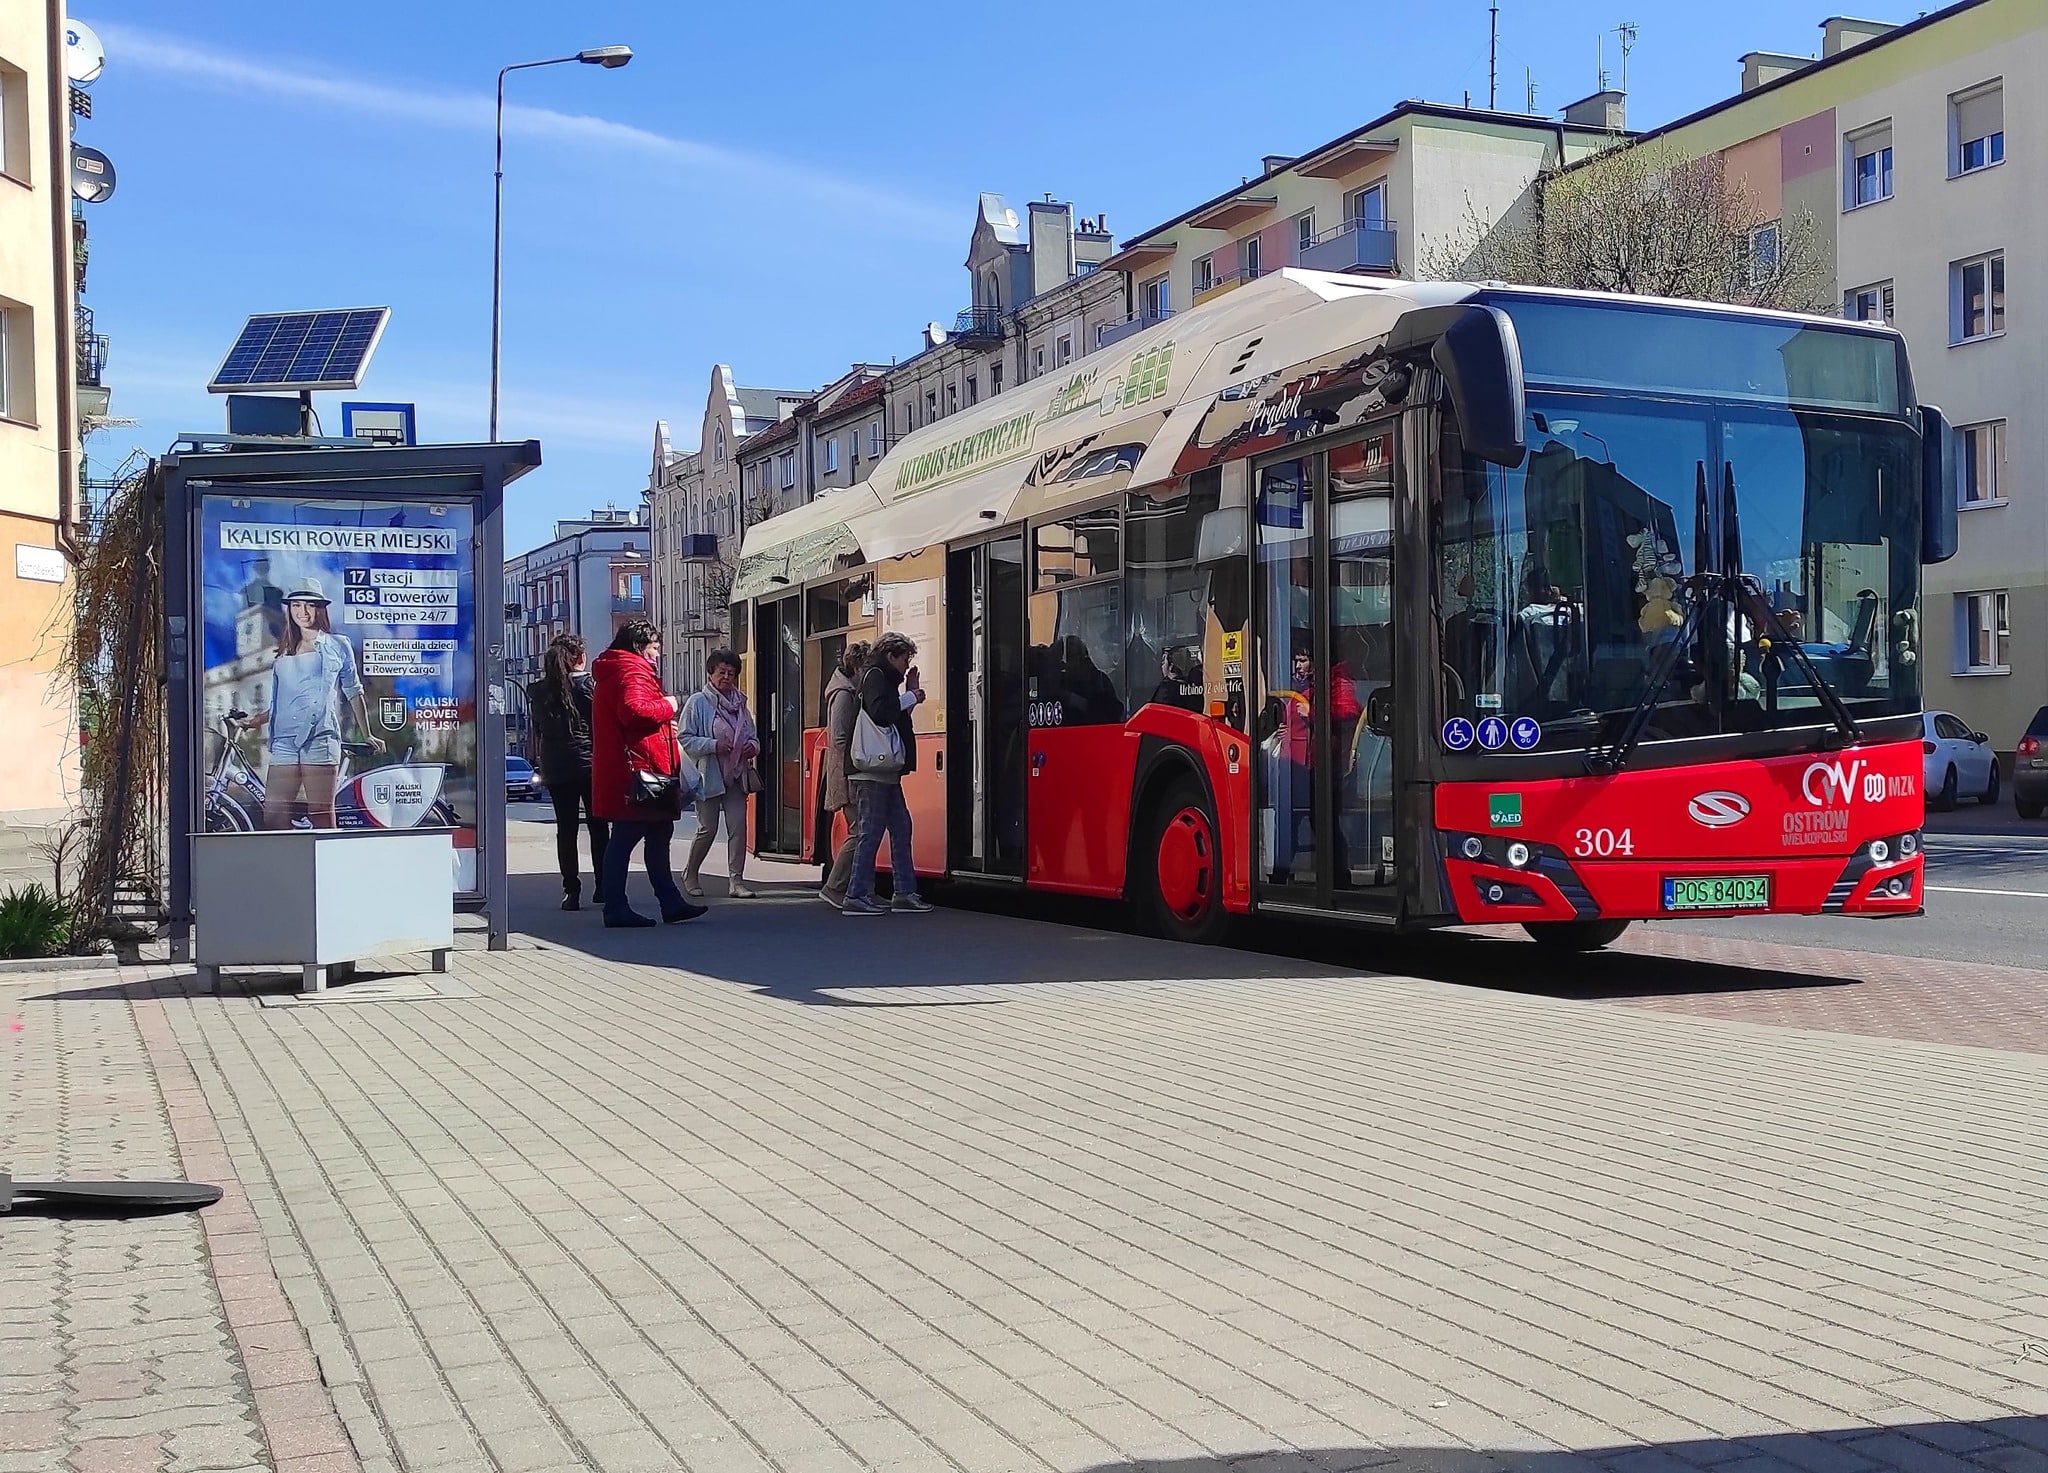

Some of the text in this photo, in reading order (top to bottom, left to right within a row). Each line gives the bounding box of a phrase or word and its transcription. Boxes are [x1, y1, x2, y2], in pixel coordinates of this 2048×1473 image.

[894, 410, 1036, 492] AUTOBUS ELEKTRYCZNY
[227, 528, 451, 550] KALISKI ROWER MIEJSKI
[349, 570, 413, 587] 17 stacji
[349, 589, 450, 604] 168 rowerów
[355, 609, 447, 624] Dostępne 24/7
[372, 641, 455, 650] Rowerki dla dzieci
[373, 653, 416, 663] Tandemy
[372, 665, 435, 675] Rowery cargo
[1179, 683, 1204, 696] Urbino
[415, 697, 459, 706] KALISKI
[415, 709, 458, 718] ROWER
[415, 721, 460, 731] MIEJSKI
[1888, 775, 1916, 797] MZK
[1500, 813, 1522, 823] AED
[1783, 805, 1850, 833] OSTRÓW
[1574, 828, 1635, 857] 304
[1781, 830, 1848, 846] WIELKOPOLSKI
[1675, 880, 1766, 902] POS 84034
